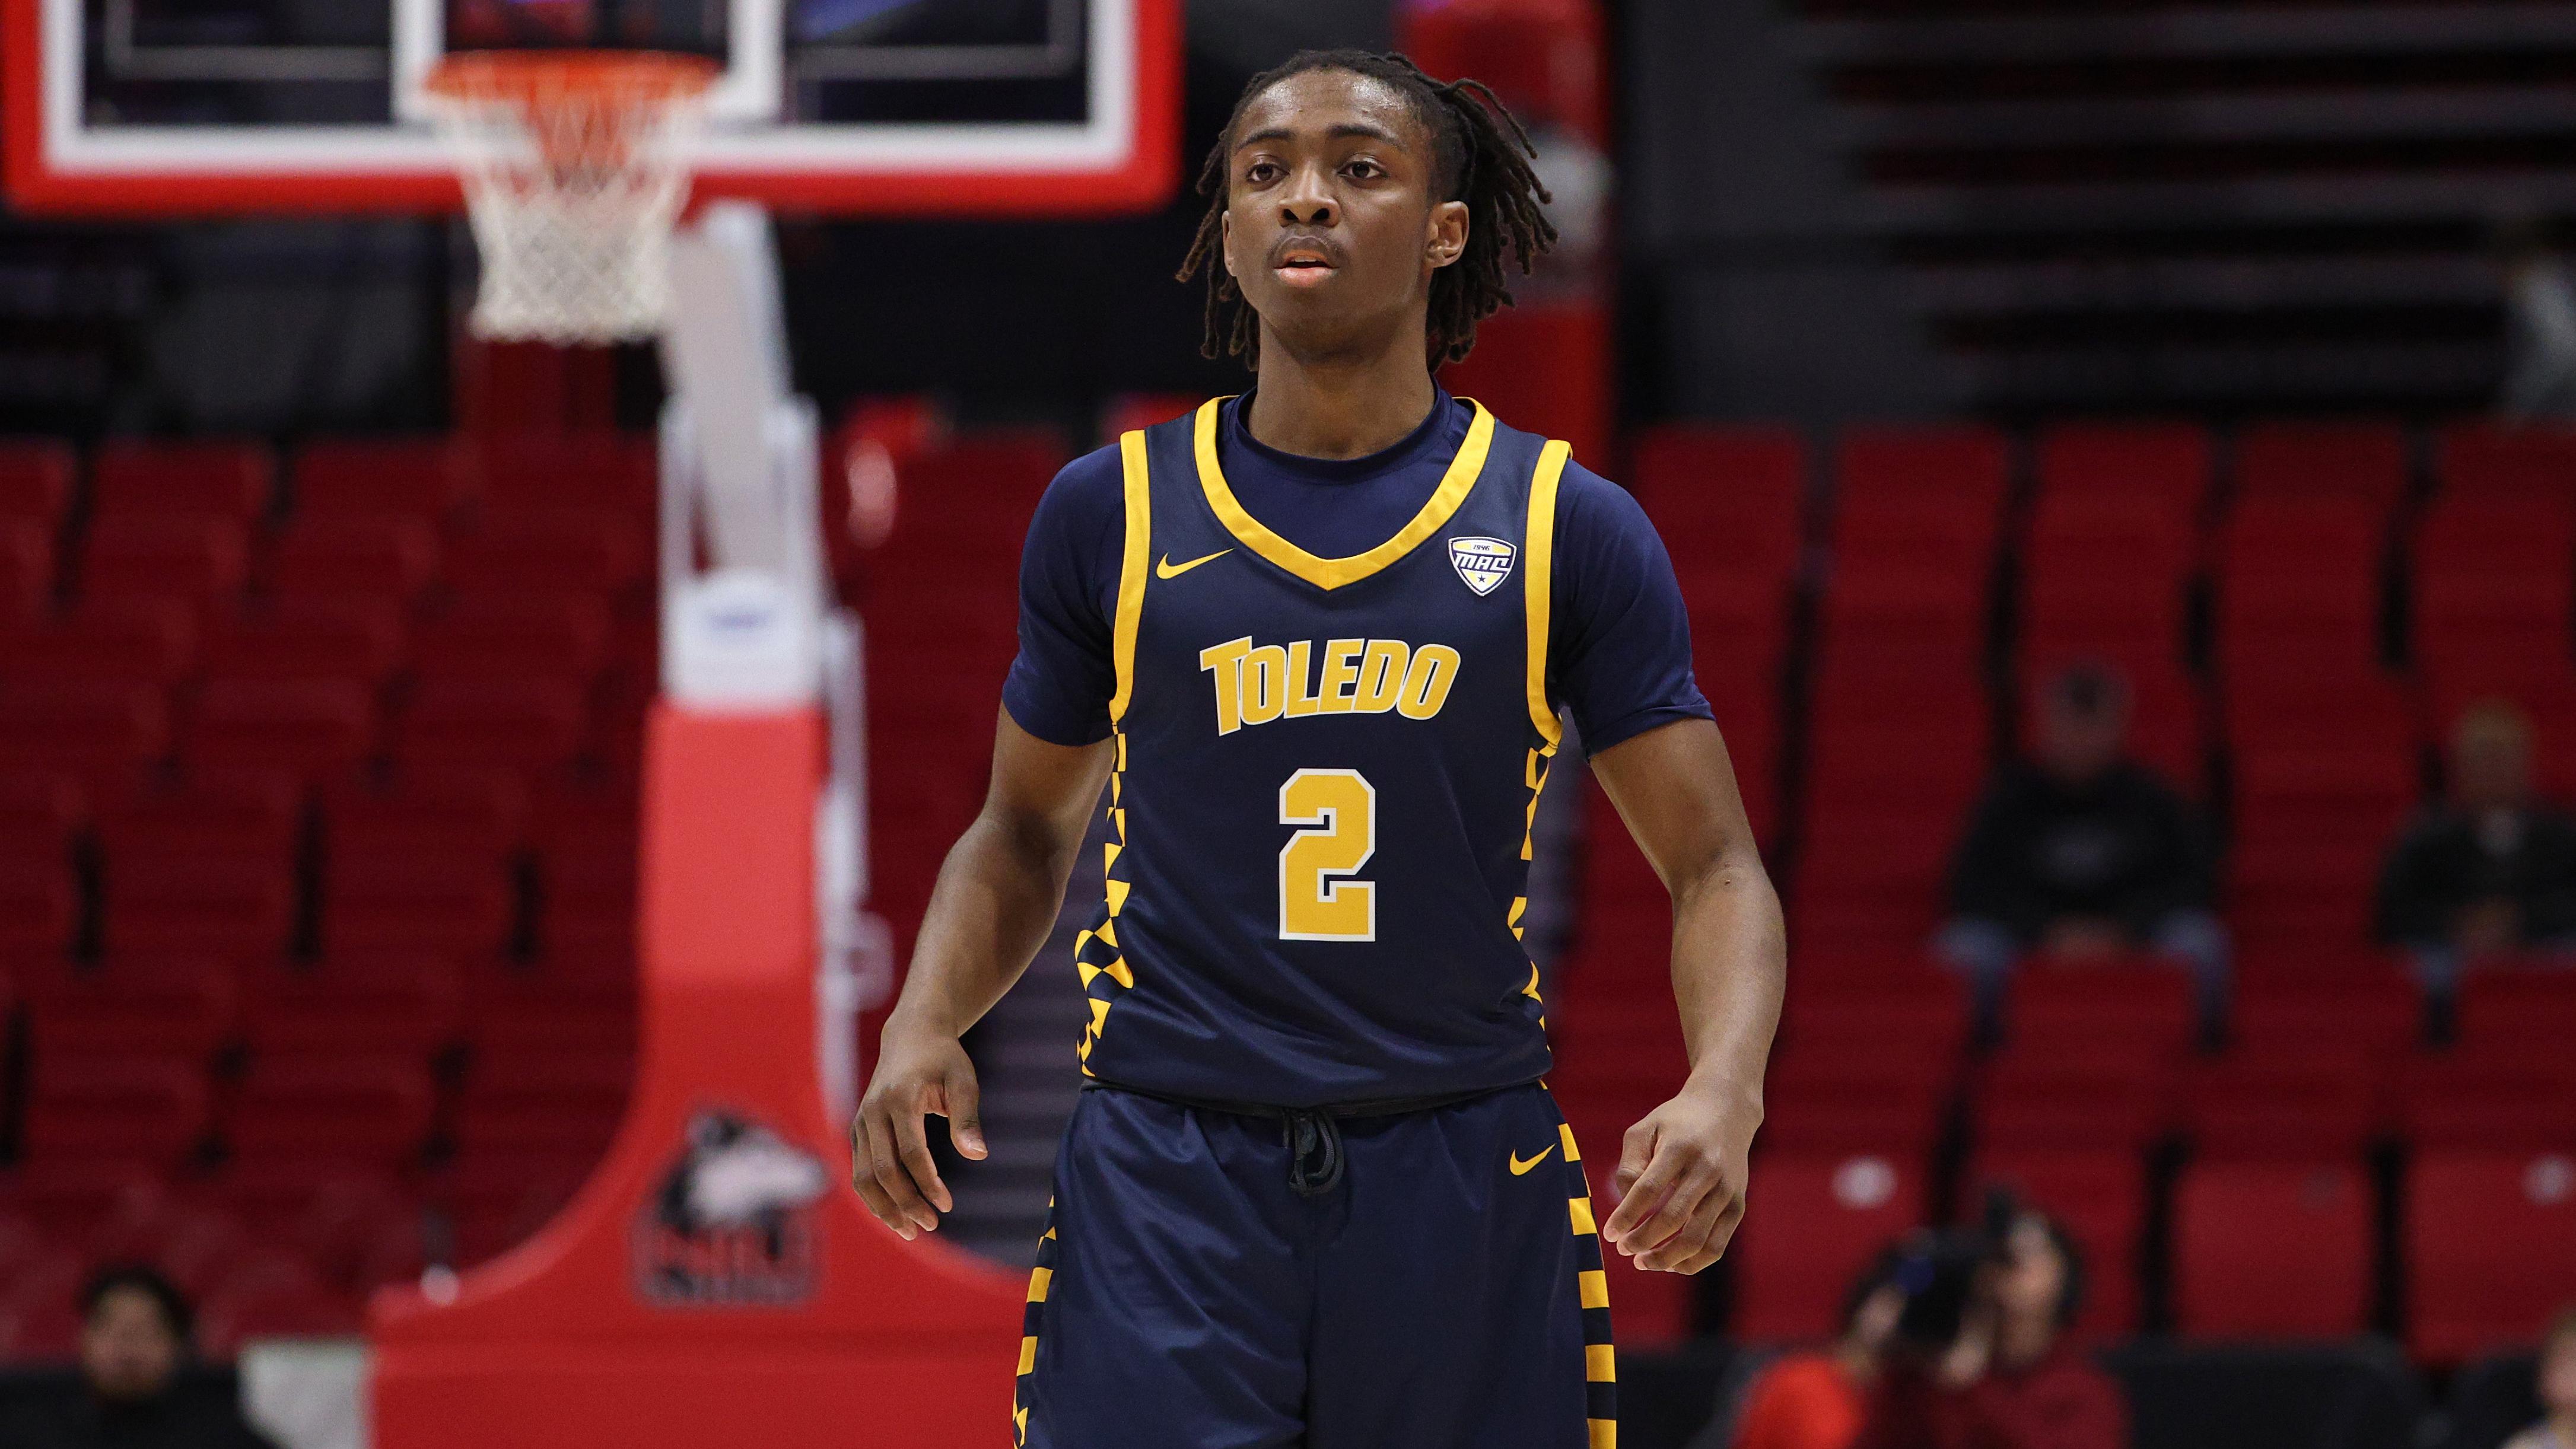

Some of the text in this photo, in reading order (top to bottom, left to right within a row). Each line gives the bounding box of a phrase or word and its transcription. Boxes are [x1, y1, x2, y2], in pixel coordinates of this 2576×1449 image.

[1455, 552, 1510, 571] MAC
[1200, 636, 1461, 737] TOLEDO
[1279, 768, 1375, 942] 2
